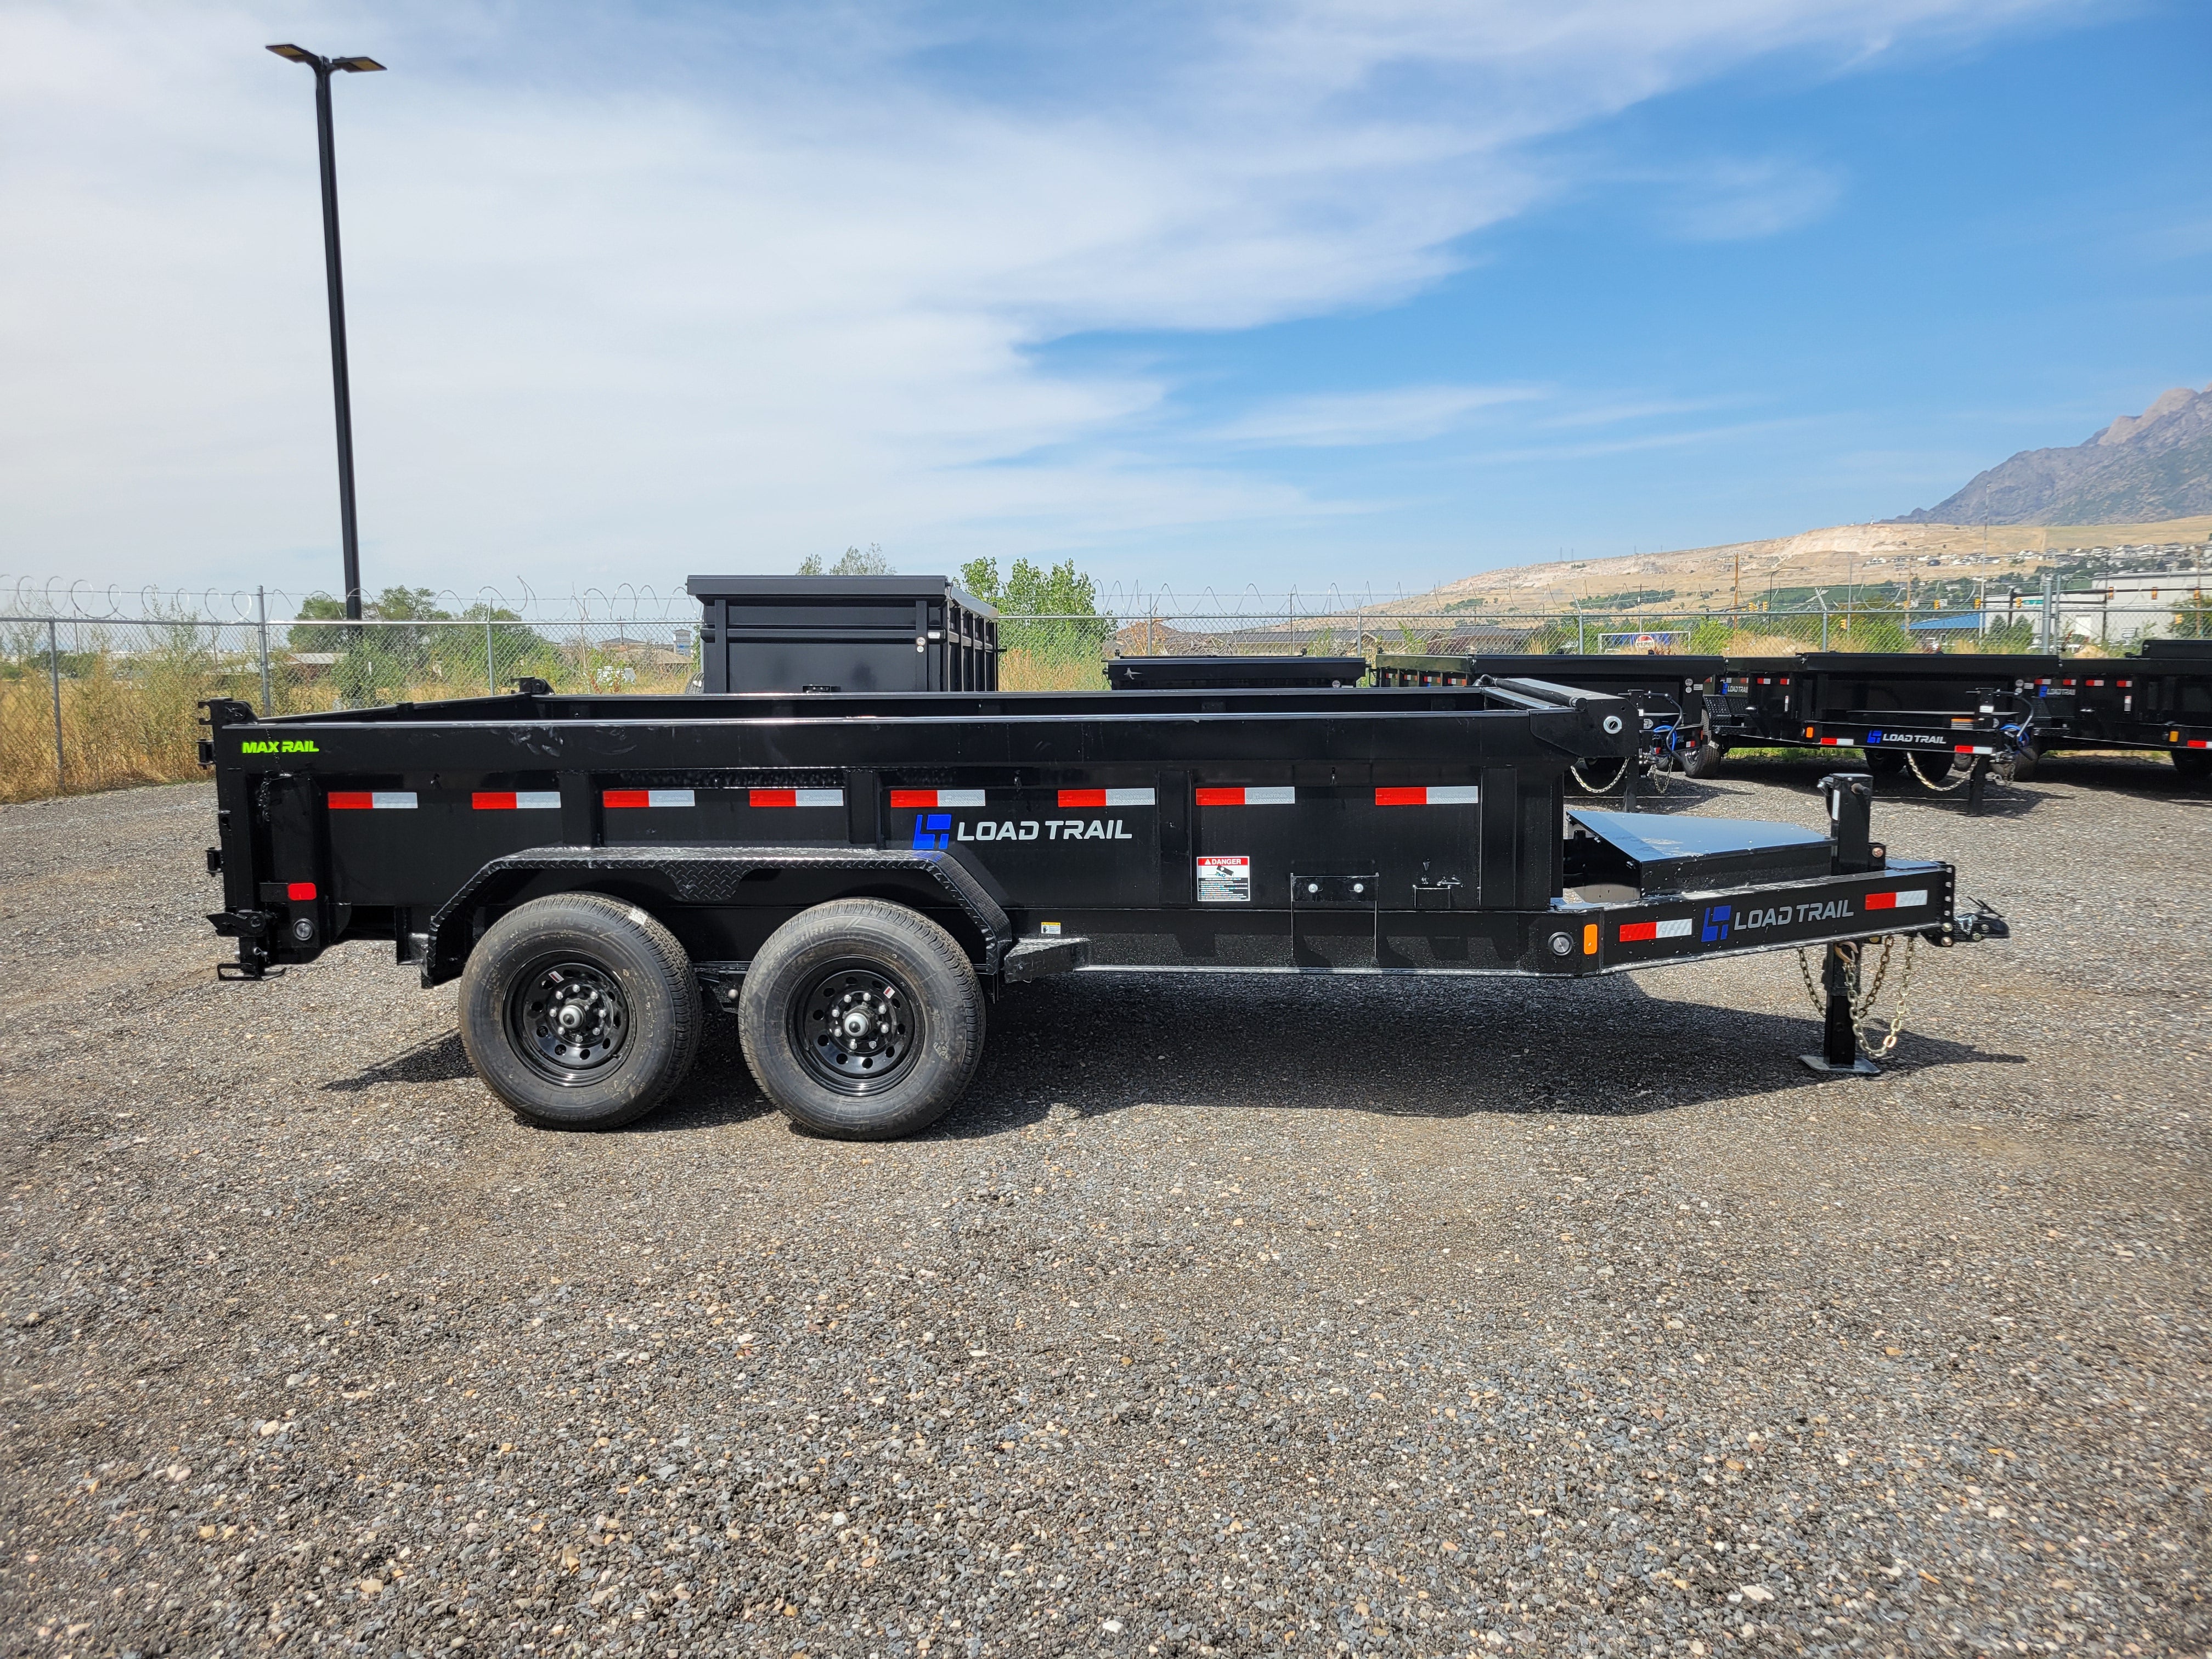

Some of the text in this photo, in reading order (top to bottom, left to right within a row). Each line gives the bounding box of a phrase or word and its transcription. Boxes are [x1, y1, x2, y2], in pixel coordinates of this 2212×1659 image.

[242, 740, 320, 753] MAX RAIL
[1882, 733, 1913, 742] LOAD
[1914, 735, 1946, 744] TRAIL
[957, 821, 1040, 841] LOAD
[1045, 820, 1132, 840] TRAIL
[1734, 906, 1792, 930] LOAD
[1796, 899, 1854, 923] TRAIL
